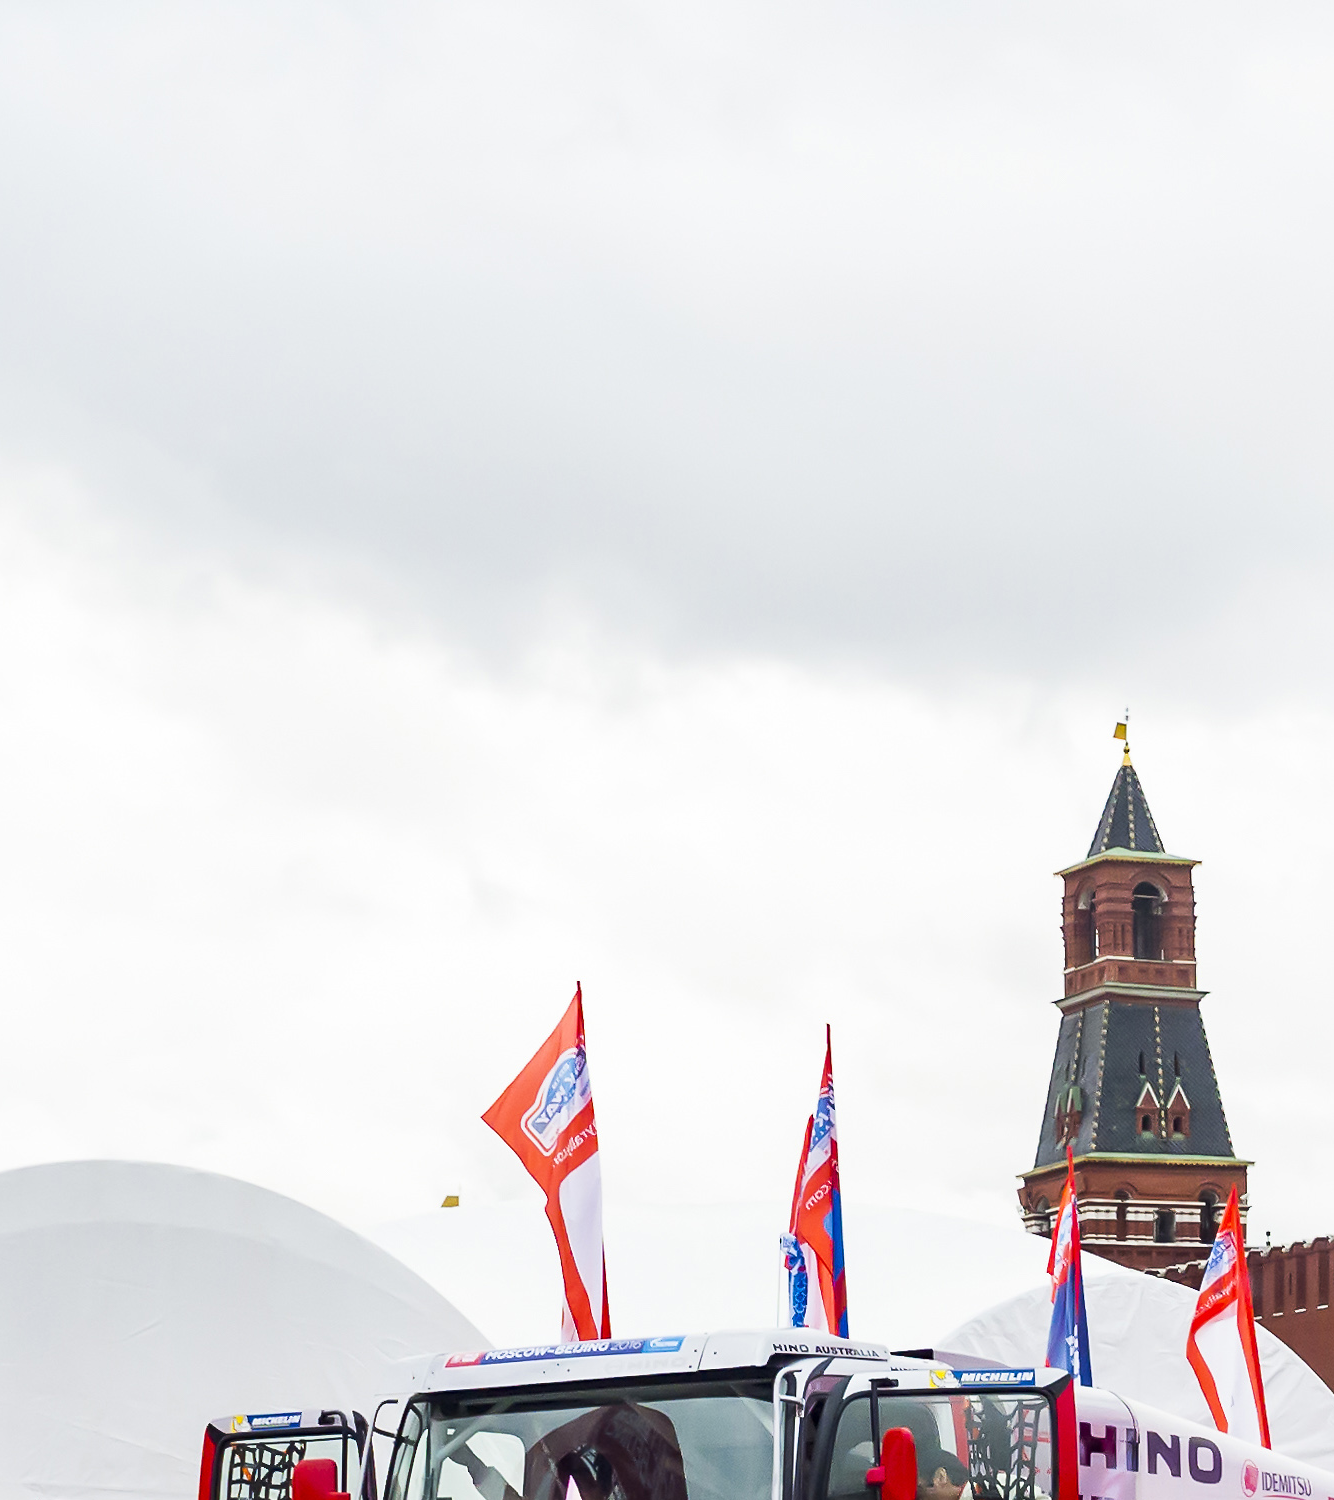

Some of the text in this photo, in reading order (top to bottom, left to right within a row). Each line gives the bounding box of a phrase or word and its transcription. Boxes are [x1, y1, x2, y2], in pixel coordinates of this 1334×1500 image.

[772, 1343, 880, 1358] HINO AUSTRALIA
[961, 1371, 1034, 1383] MICHELIN
[1079, 1422, 1223, 1484] HINO
[1261, 1471, 1312, 1497] IDEMITSU
